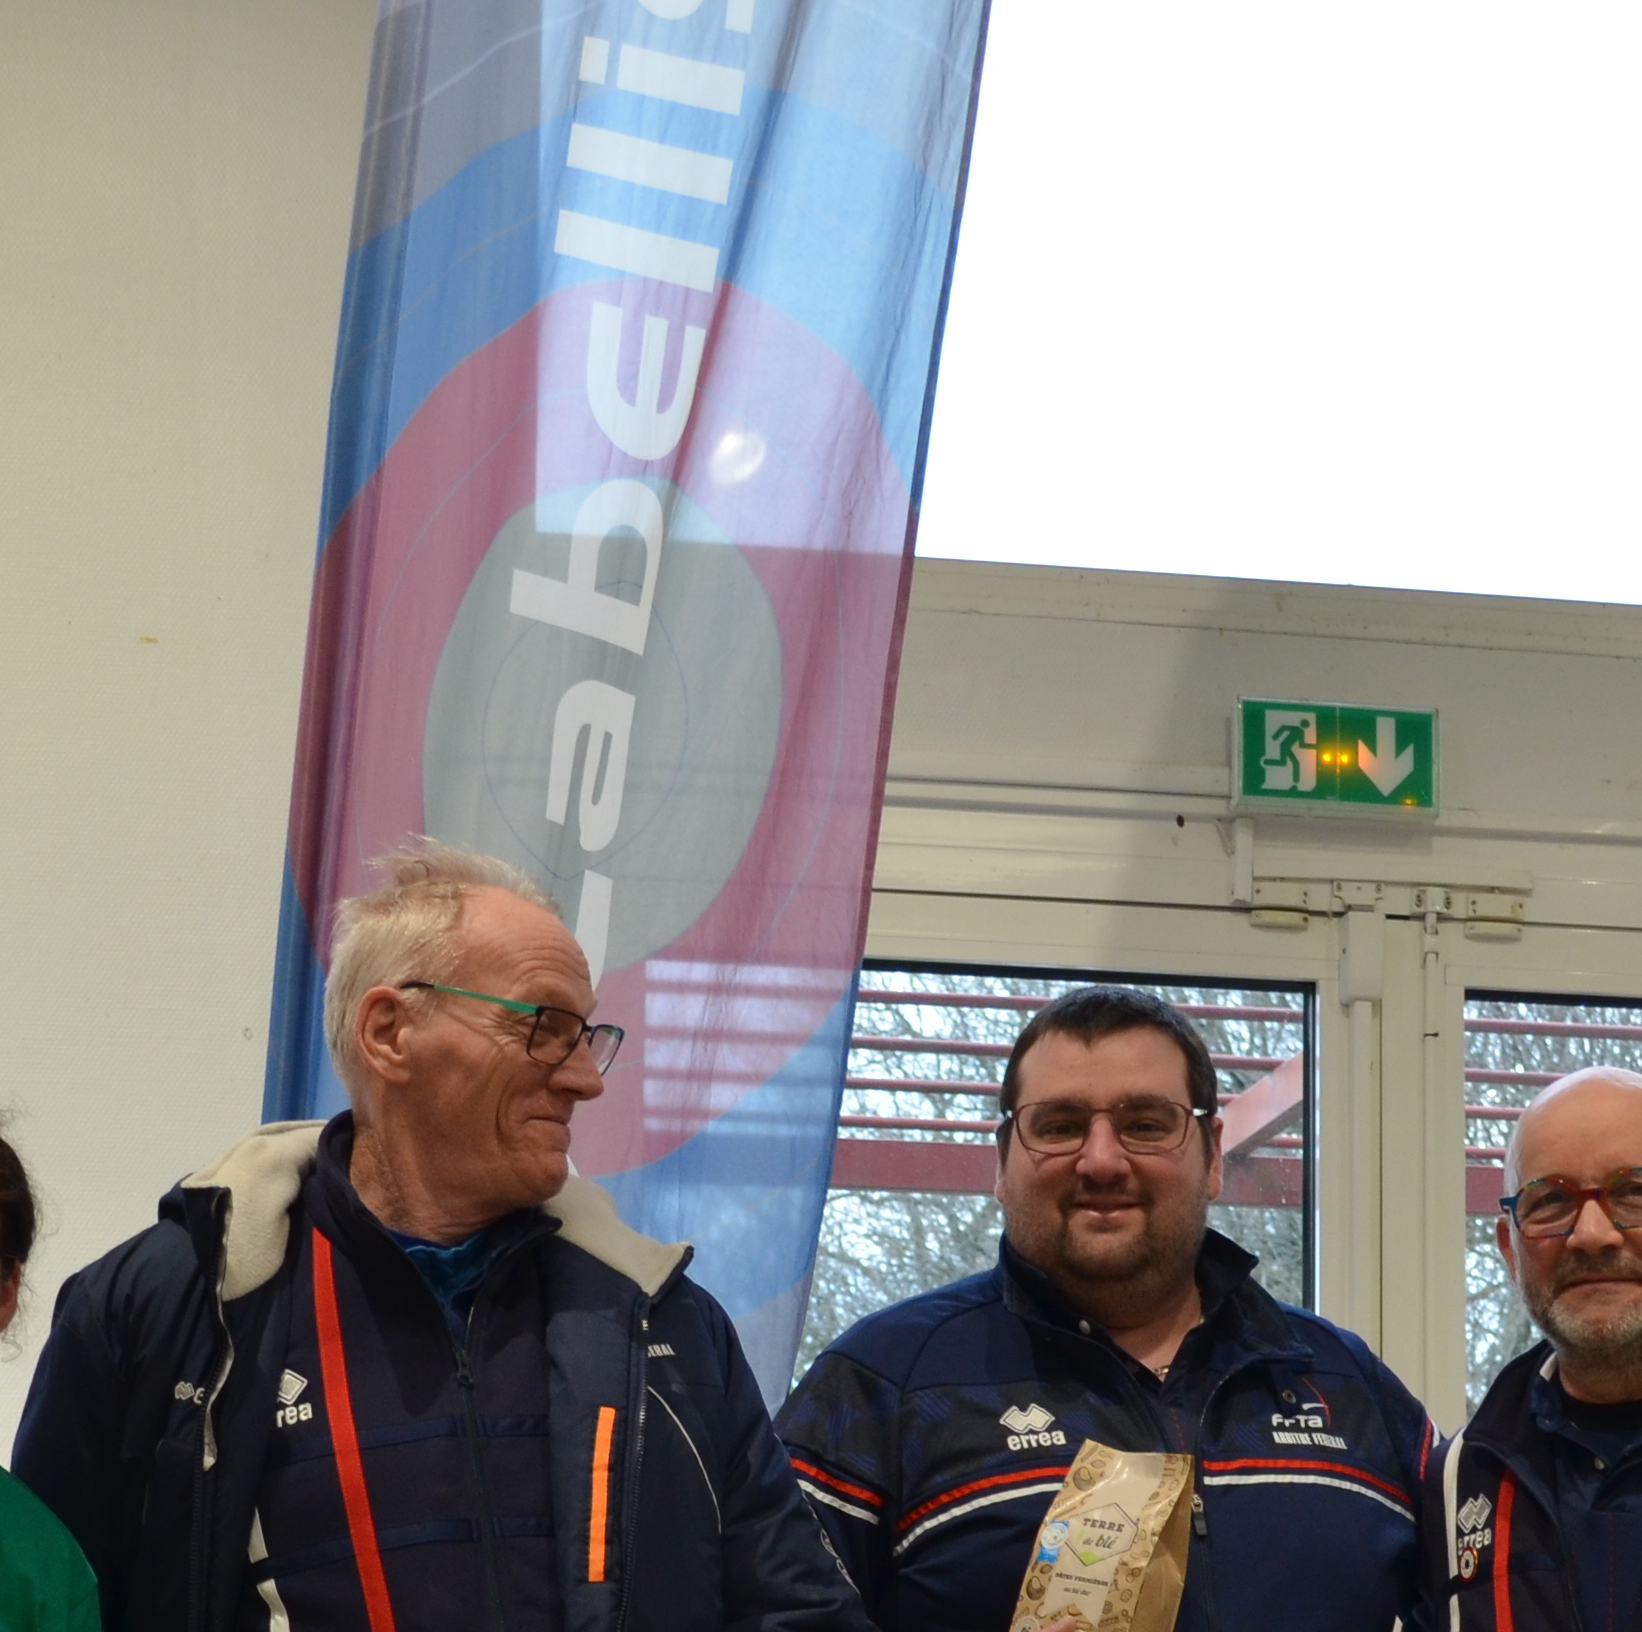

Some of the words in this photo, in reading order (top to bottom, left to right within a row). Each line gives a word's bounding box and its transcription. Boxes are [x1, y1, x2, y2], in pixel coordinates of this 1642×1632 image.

[1006, 1430, 1067, 1451] errea
[1082, 1517, 1126, 1534] TERRE
[1095, 1533, 1119, 1550] blé
